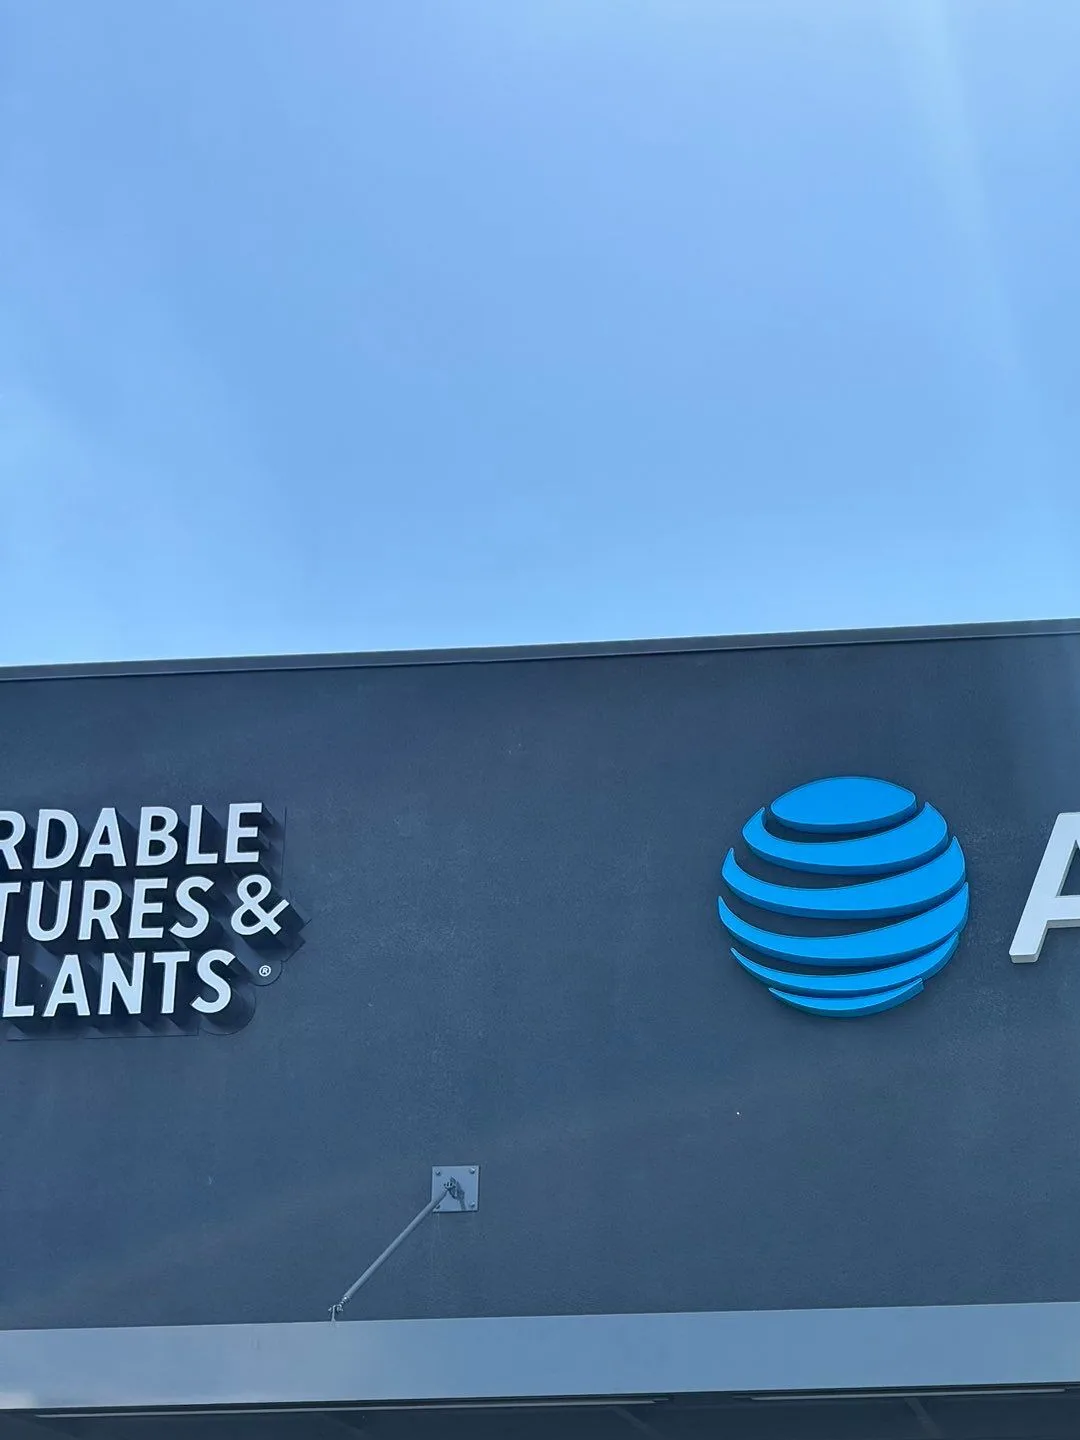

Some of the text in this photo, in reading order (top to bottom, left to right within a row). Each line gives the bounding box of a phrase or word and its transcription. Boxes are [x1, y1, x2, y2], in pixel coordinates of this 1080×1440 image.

[0, 803, 262, 870] RDABLE
[231, 874, 290, 935] &
[2, 949, 236, 1017] LANTS
